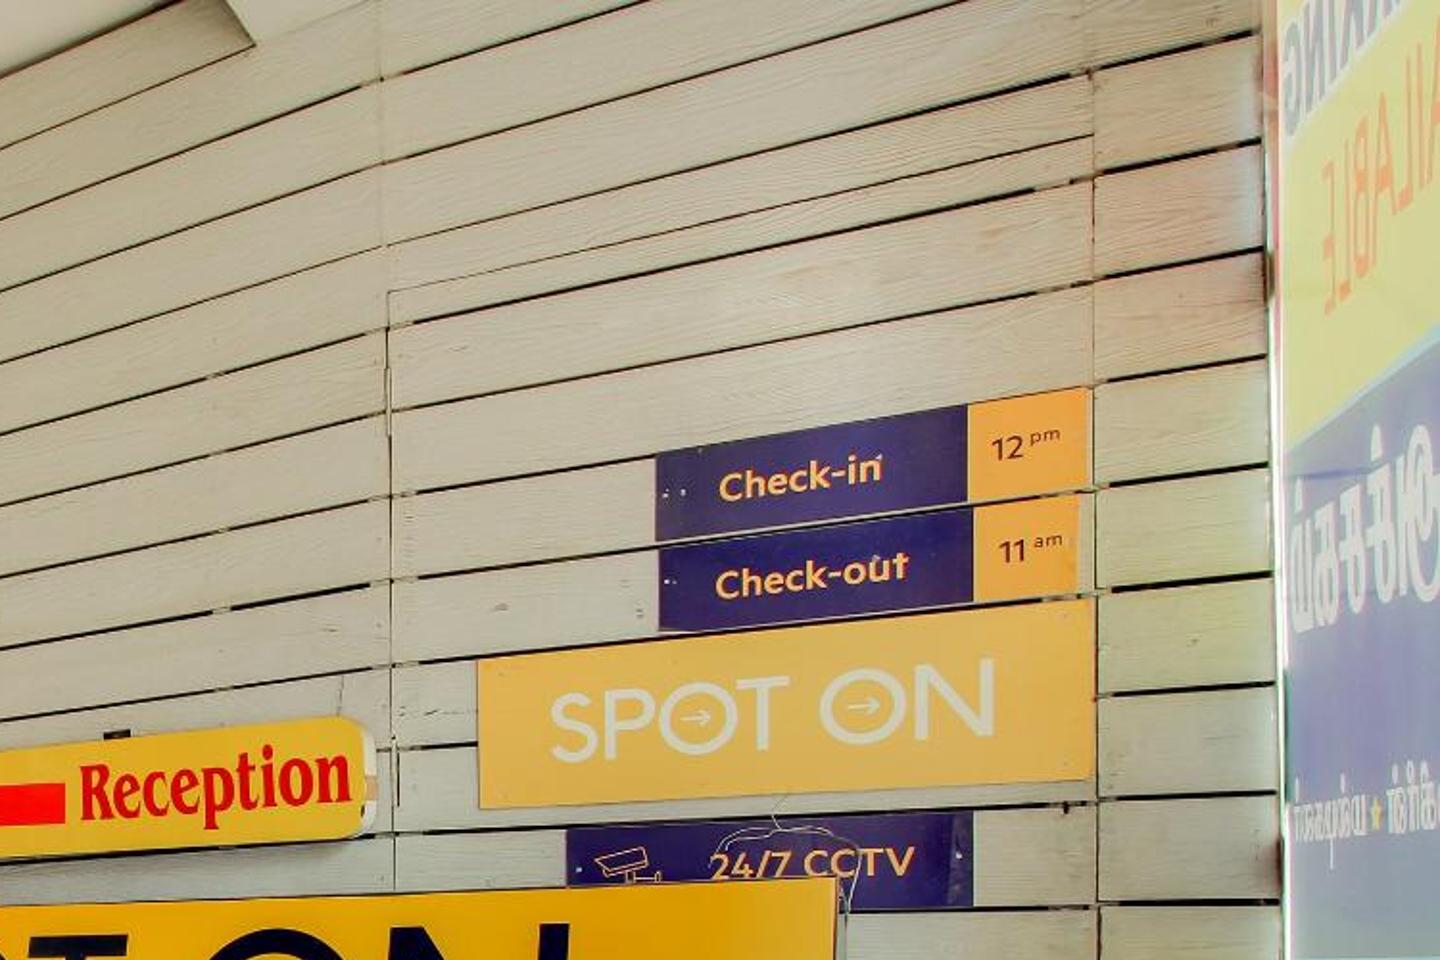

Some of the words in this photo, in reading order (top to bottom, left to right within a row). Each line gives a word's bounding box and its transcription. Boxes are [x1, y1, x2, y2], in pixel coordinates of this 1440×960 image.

[718, 453, 883, 502] Check-in
[992, 435, 1024, 461] 12
[1029, 429, 1061, 446] pm
[714, 551, 909, 600] Check-out
[998, 539, 1025, 563] 11
[1034, 534, 1063, 548] am
[549, 674, 791, 765] SPOT
[819, 658, 996, 745] ON
[78, 744, 352, 831] Reception
[709, 849, 793, 881] 24/7
[803, 846, 916, 879] CCTV
